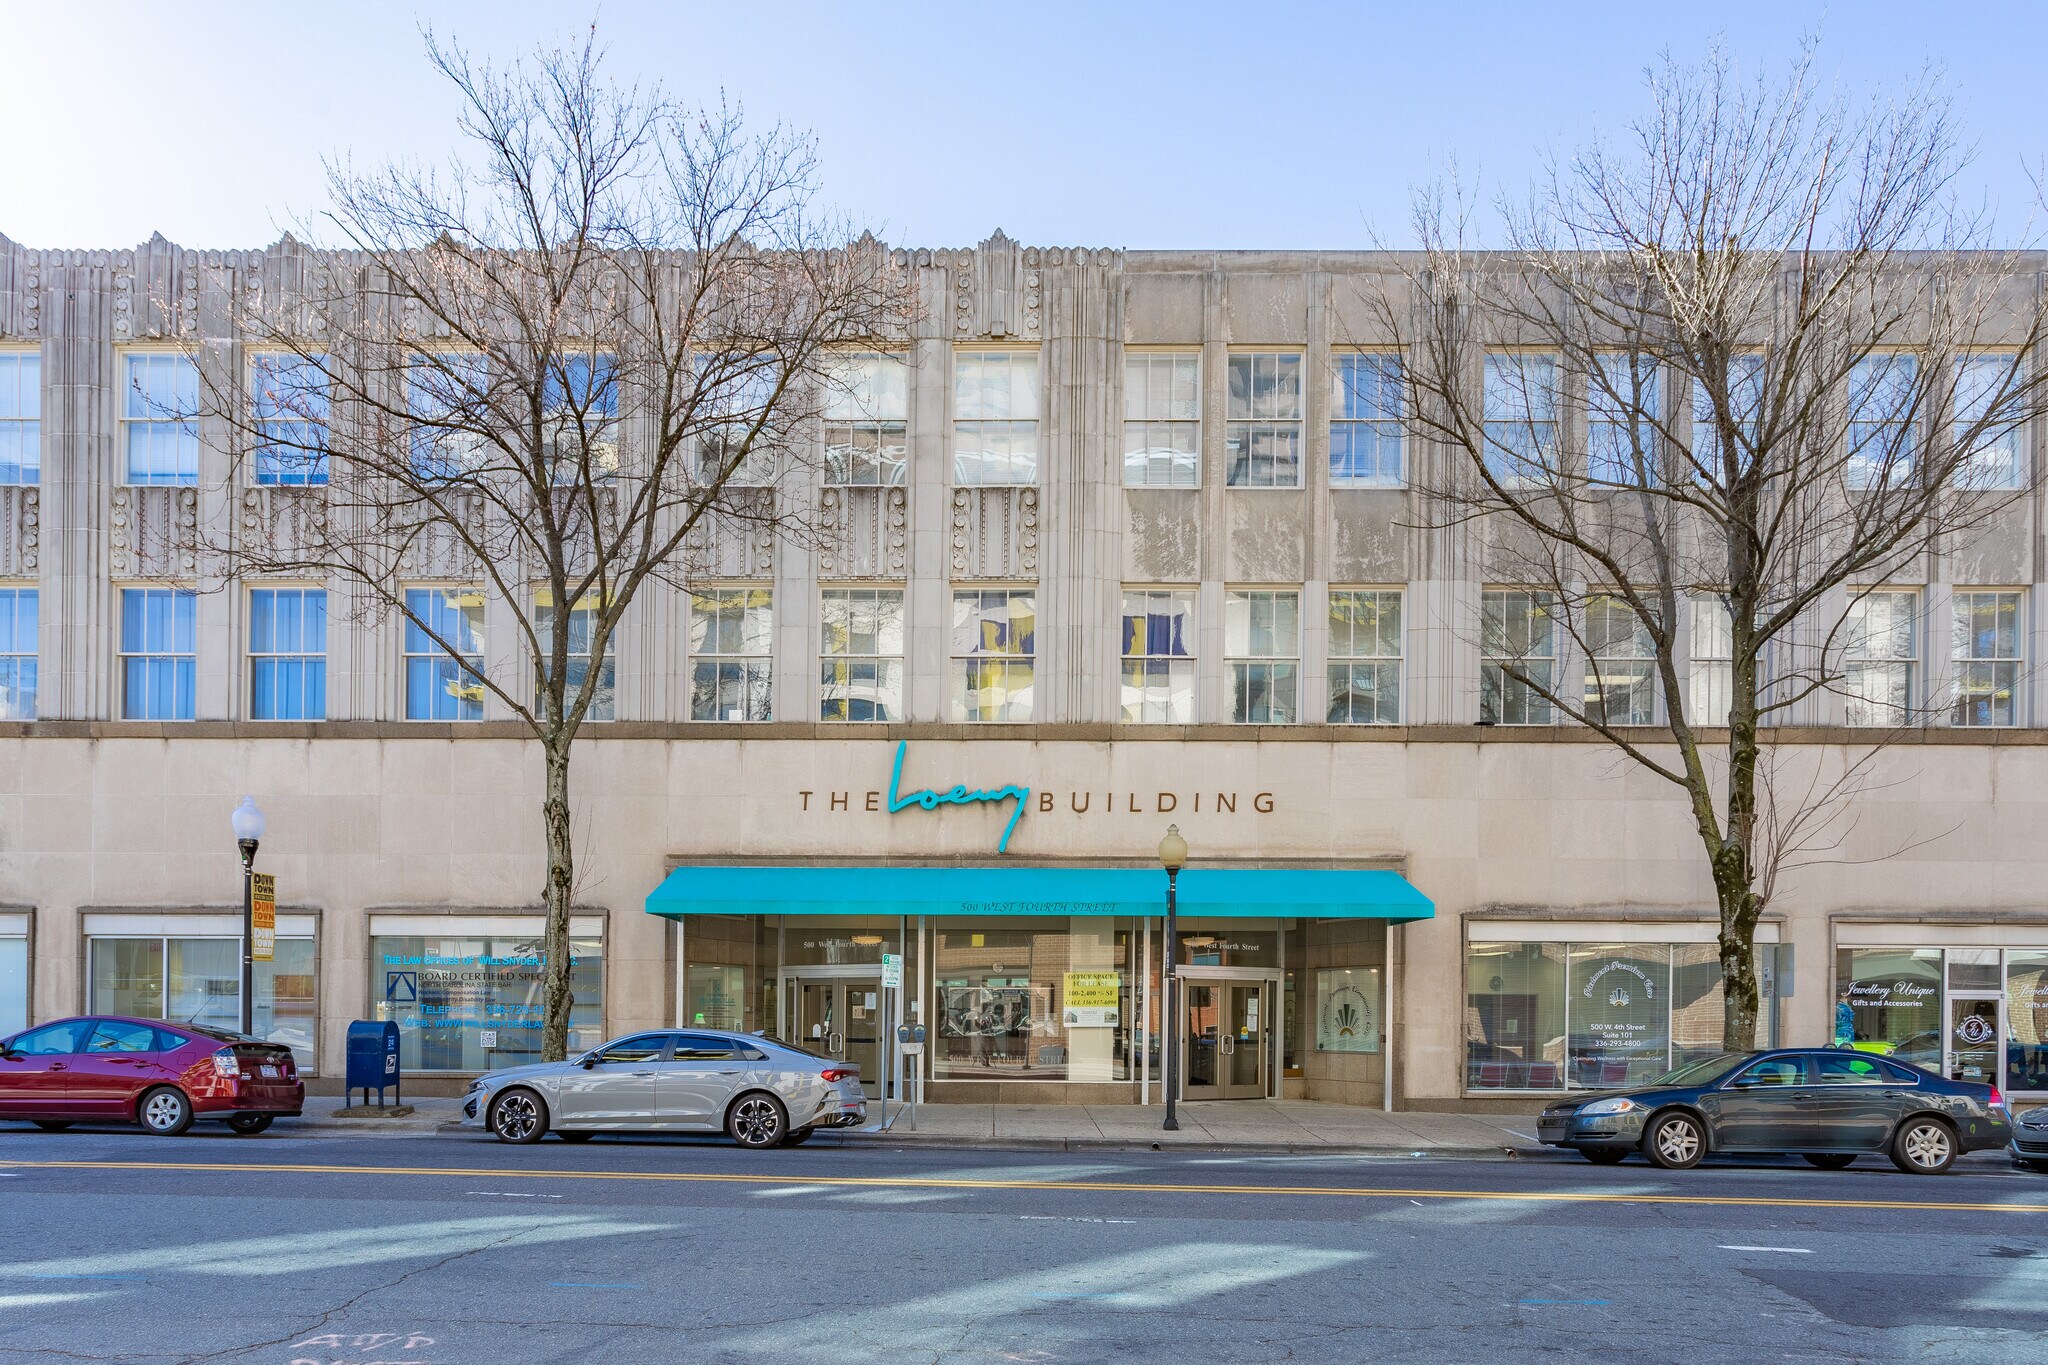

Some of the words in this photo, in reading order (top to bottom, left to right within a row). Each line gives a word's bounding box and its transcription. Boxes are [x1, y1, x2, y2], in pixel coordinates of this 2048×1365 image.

[799, 791, 880, 812] THE
[888, 740, 1030, 853] Loewy
[1038, 791, 1275, 813] BUILDING
[254, 885, 274, 895] TOWN
[254, 901, 274, 912] DOWN
[960, 902, 979, 912] 500
[981, 902, 1016, 912] WEST
[1018, 902, 1068, 912] FOURTH
[1071, 902, 1118, 912] STREET
[254, 912, 274, 922] TOWN
[254, 939, 274, 948] TOWN
[803, 941, 815, 949] 500
[1219, 942, 1239, 950] Fourth
[1242, 942, 1260, 951] Street
[383, 955, 401, 965] THE
[403, 955, 422, 965] LAW
[424, 955, 460, 965] OFFICES
[478, 955, 501, 965] WILL
[418, 973, 457, 981] BOARD
[461, 973, 515, 981] CERTIFIED
[1583, 965, 1610, 999] Piedmont
[1610, 960, 1646, 980] Premium
[1643, 978, 1654, 999] Care
[1841, 980, 1891, 999] Jewellery
[1893, 980, 1935, 999] Unique
